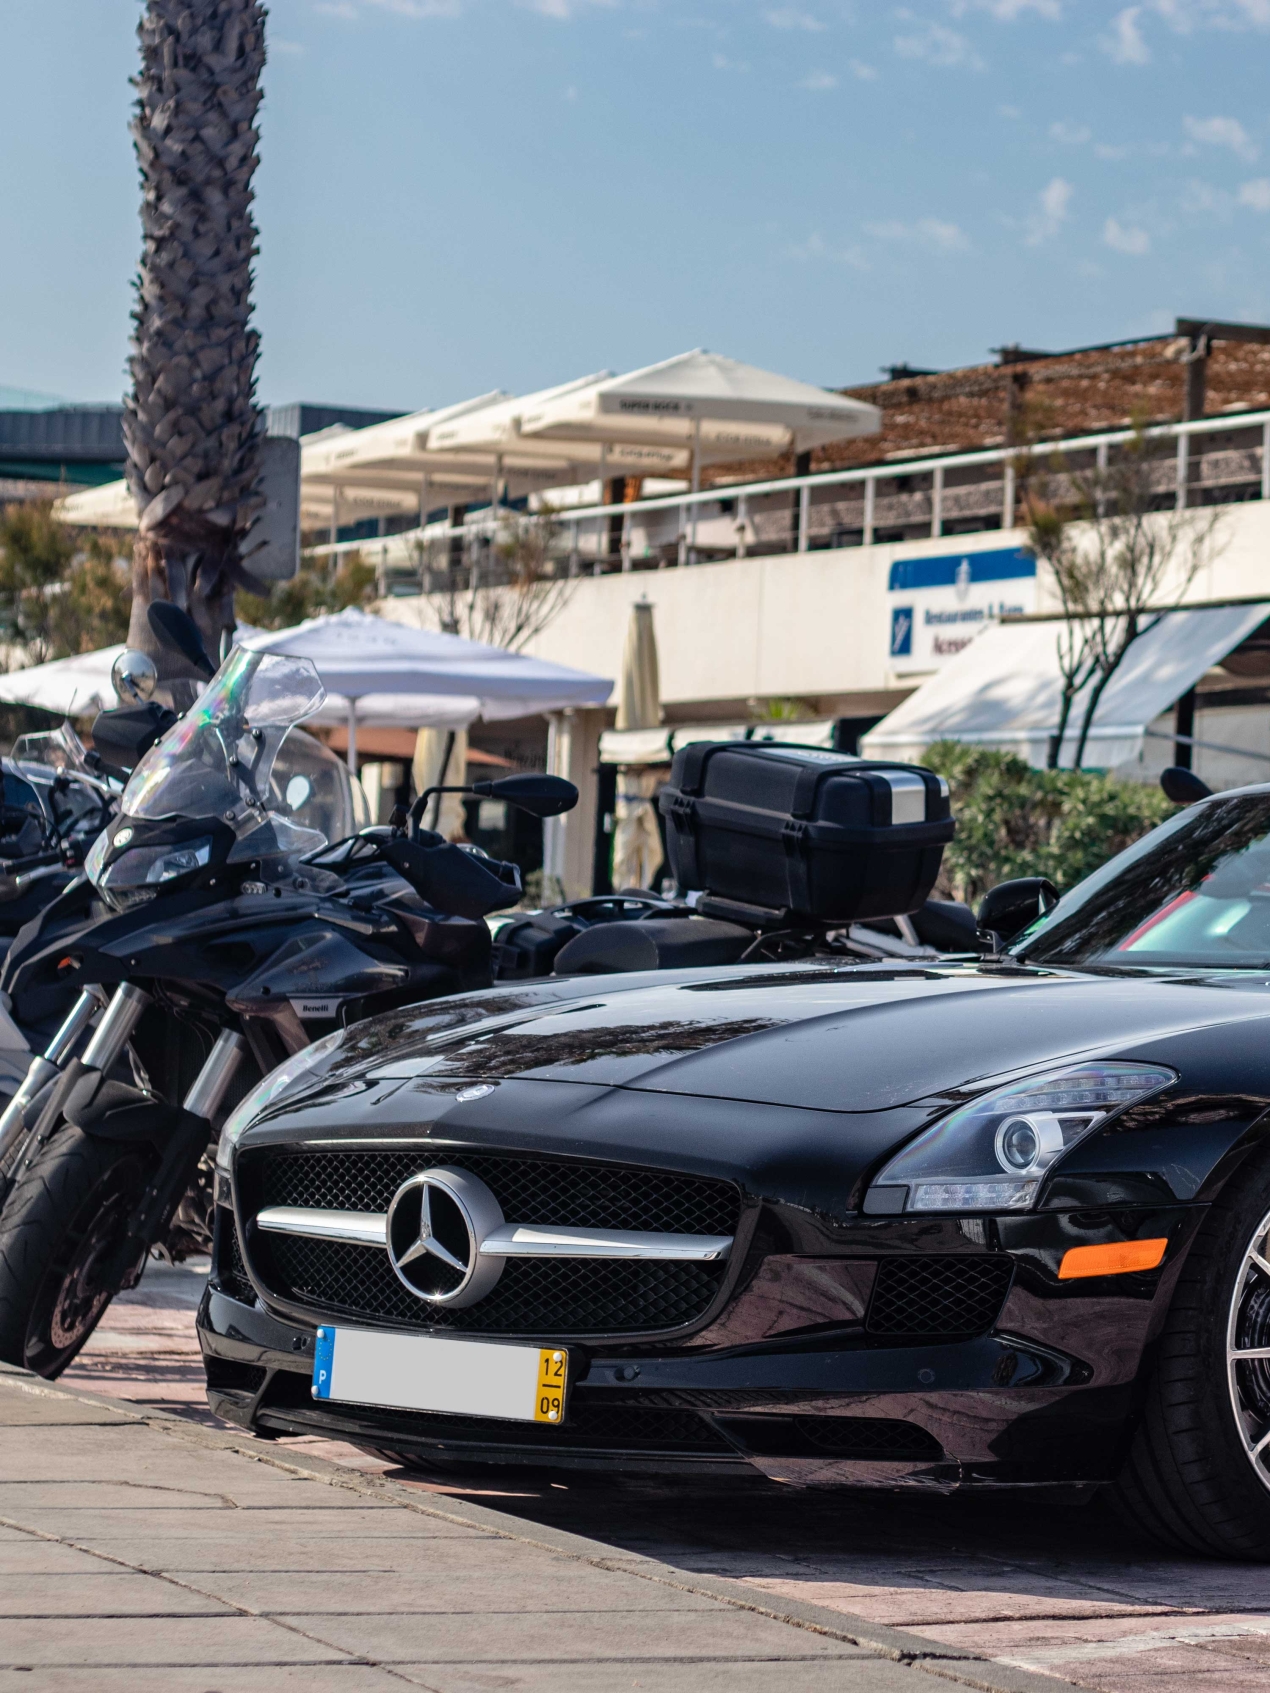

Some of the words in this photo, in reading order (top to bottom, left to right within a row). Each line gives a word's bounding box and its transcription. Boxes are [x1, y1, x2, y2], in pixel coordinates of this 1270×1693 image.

[303, 1004, 329, 1012] Benelli
[544, 1358, 563, 1377] 12
[318, 1369, 327, 1385] P
[540, 1396, 560, 1415] 09
